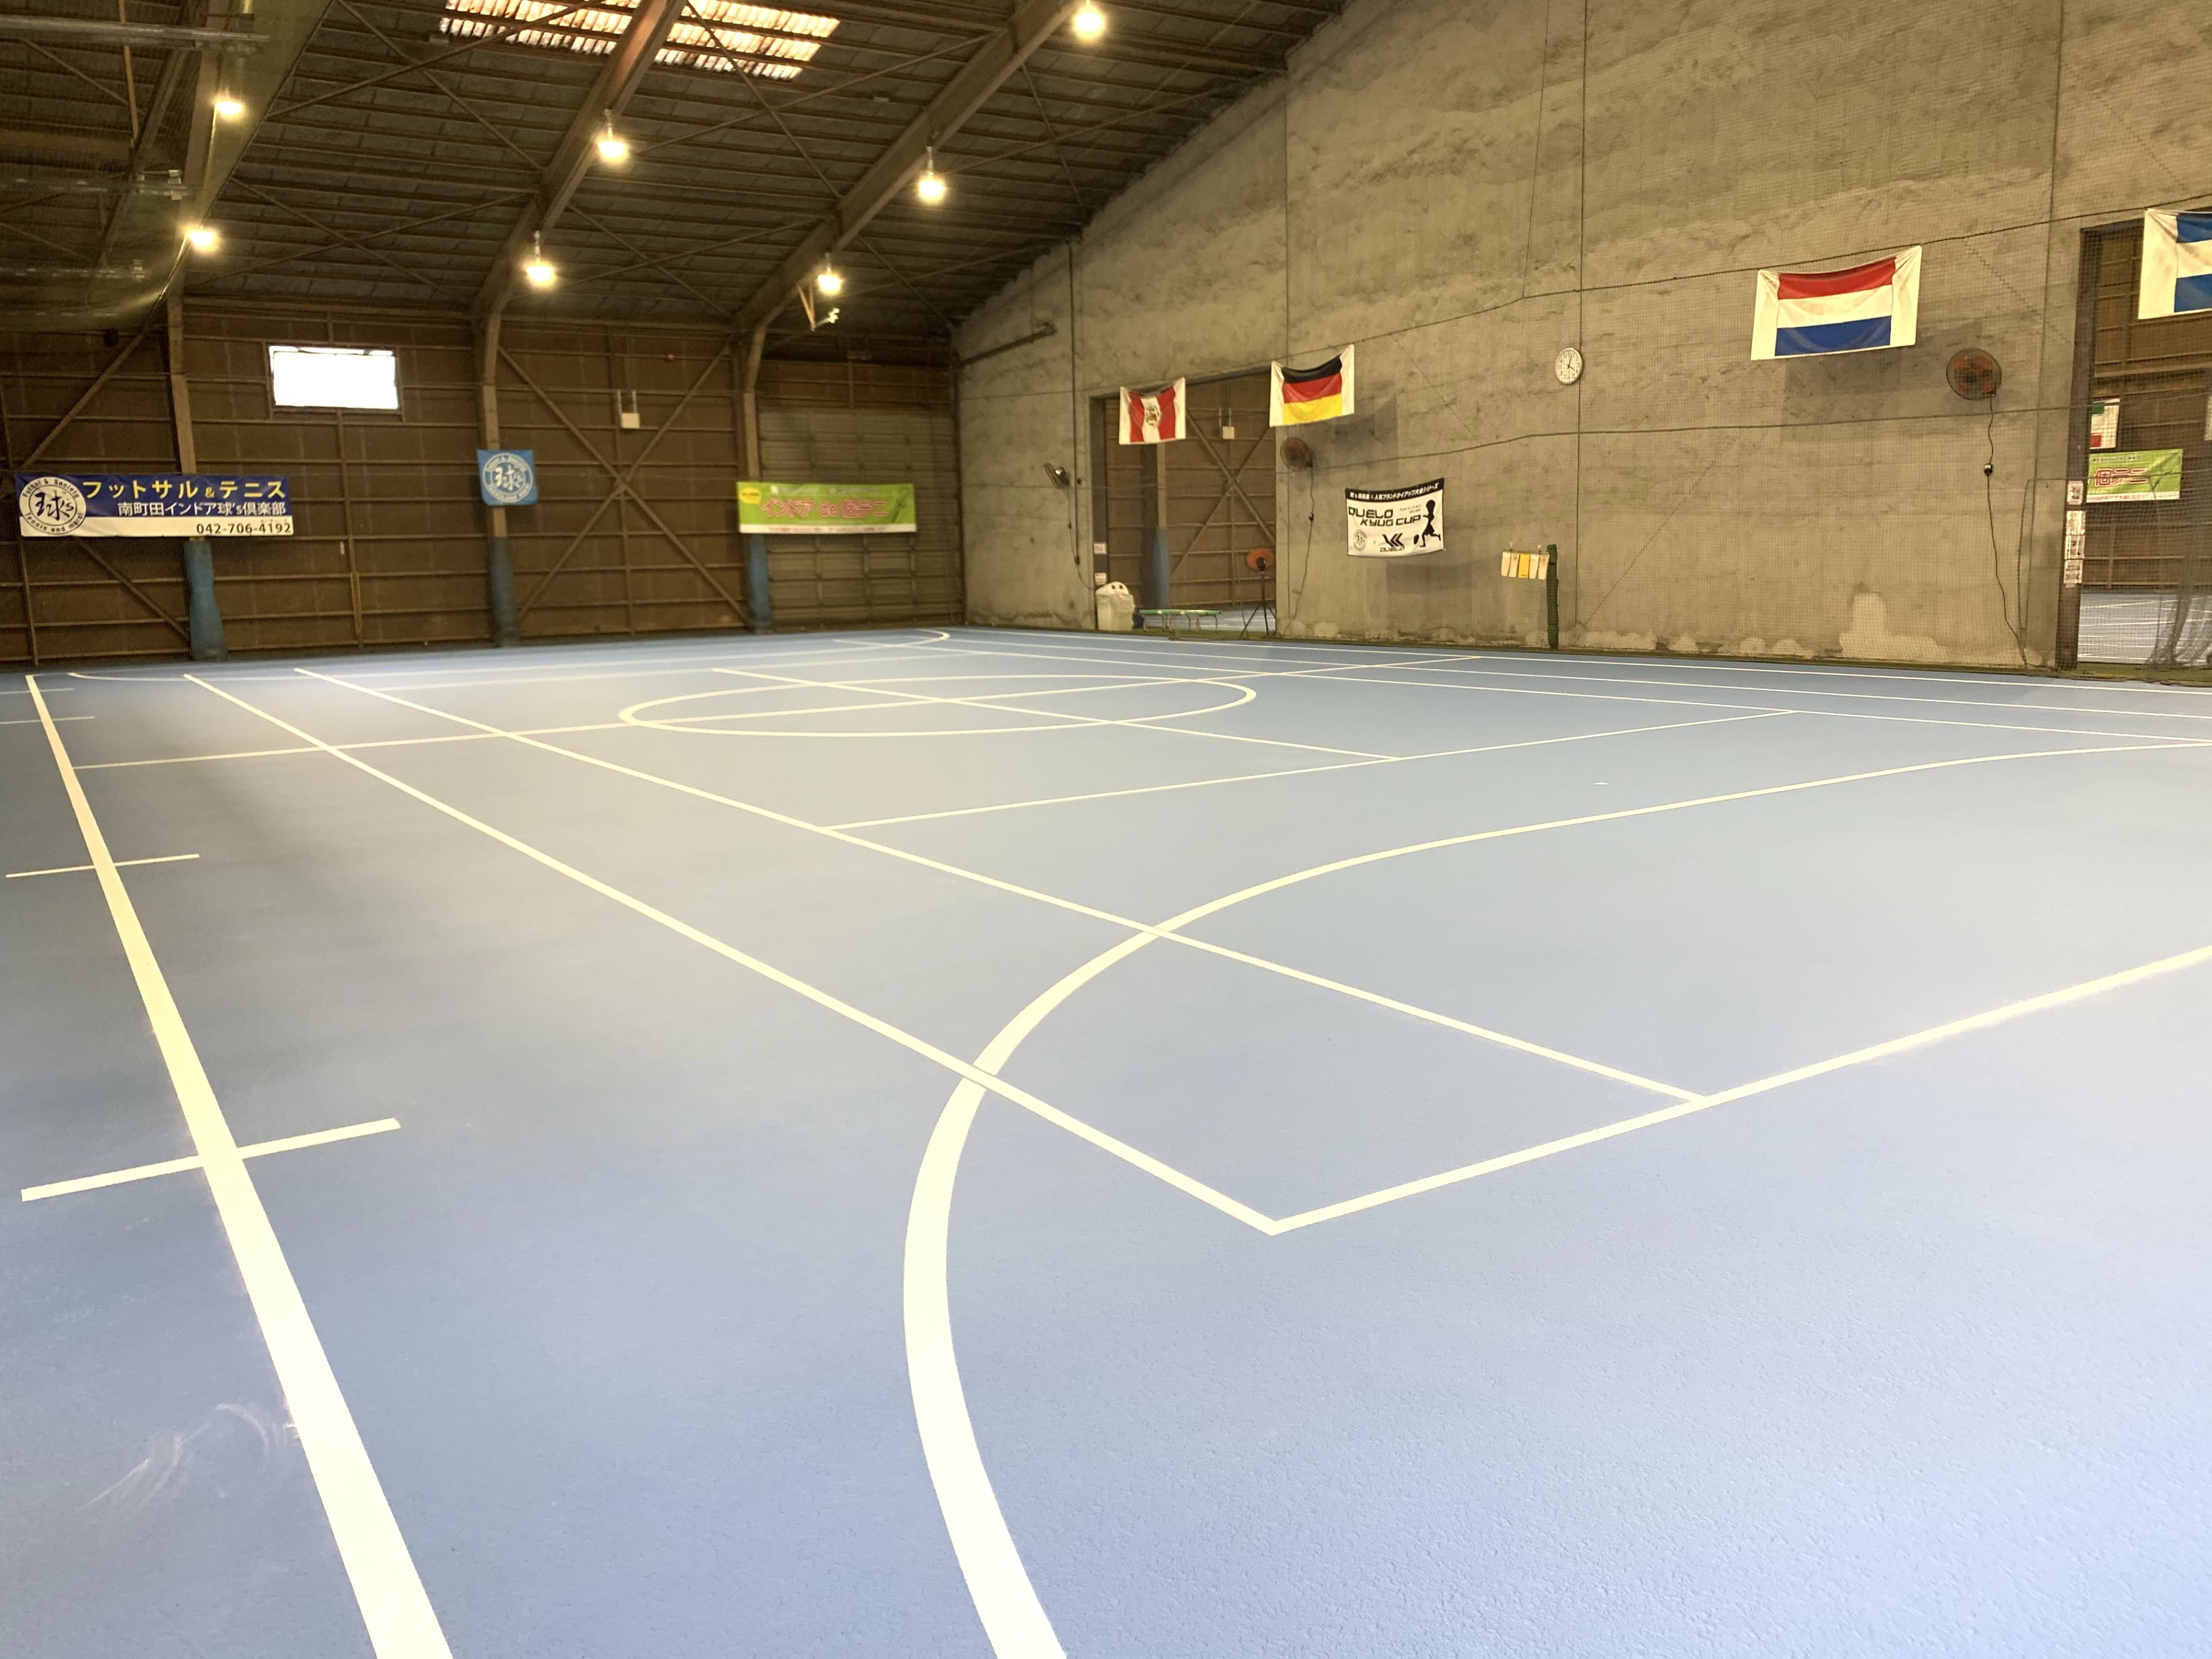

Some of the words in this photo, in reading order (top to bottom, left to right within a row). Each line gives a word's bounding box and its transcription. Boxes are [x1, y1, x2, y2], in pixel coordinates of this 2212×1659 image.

[22, 479, 41, 498] Futsal
[54, 479, 80, 498] Society
[1349, 506, 1393, 518] DUELO
[25, 512, 47, 531] Tennis
[1395, 514, 1421, 526] CUP
[196, 523, 291, 535] 042-706-4192
